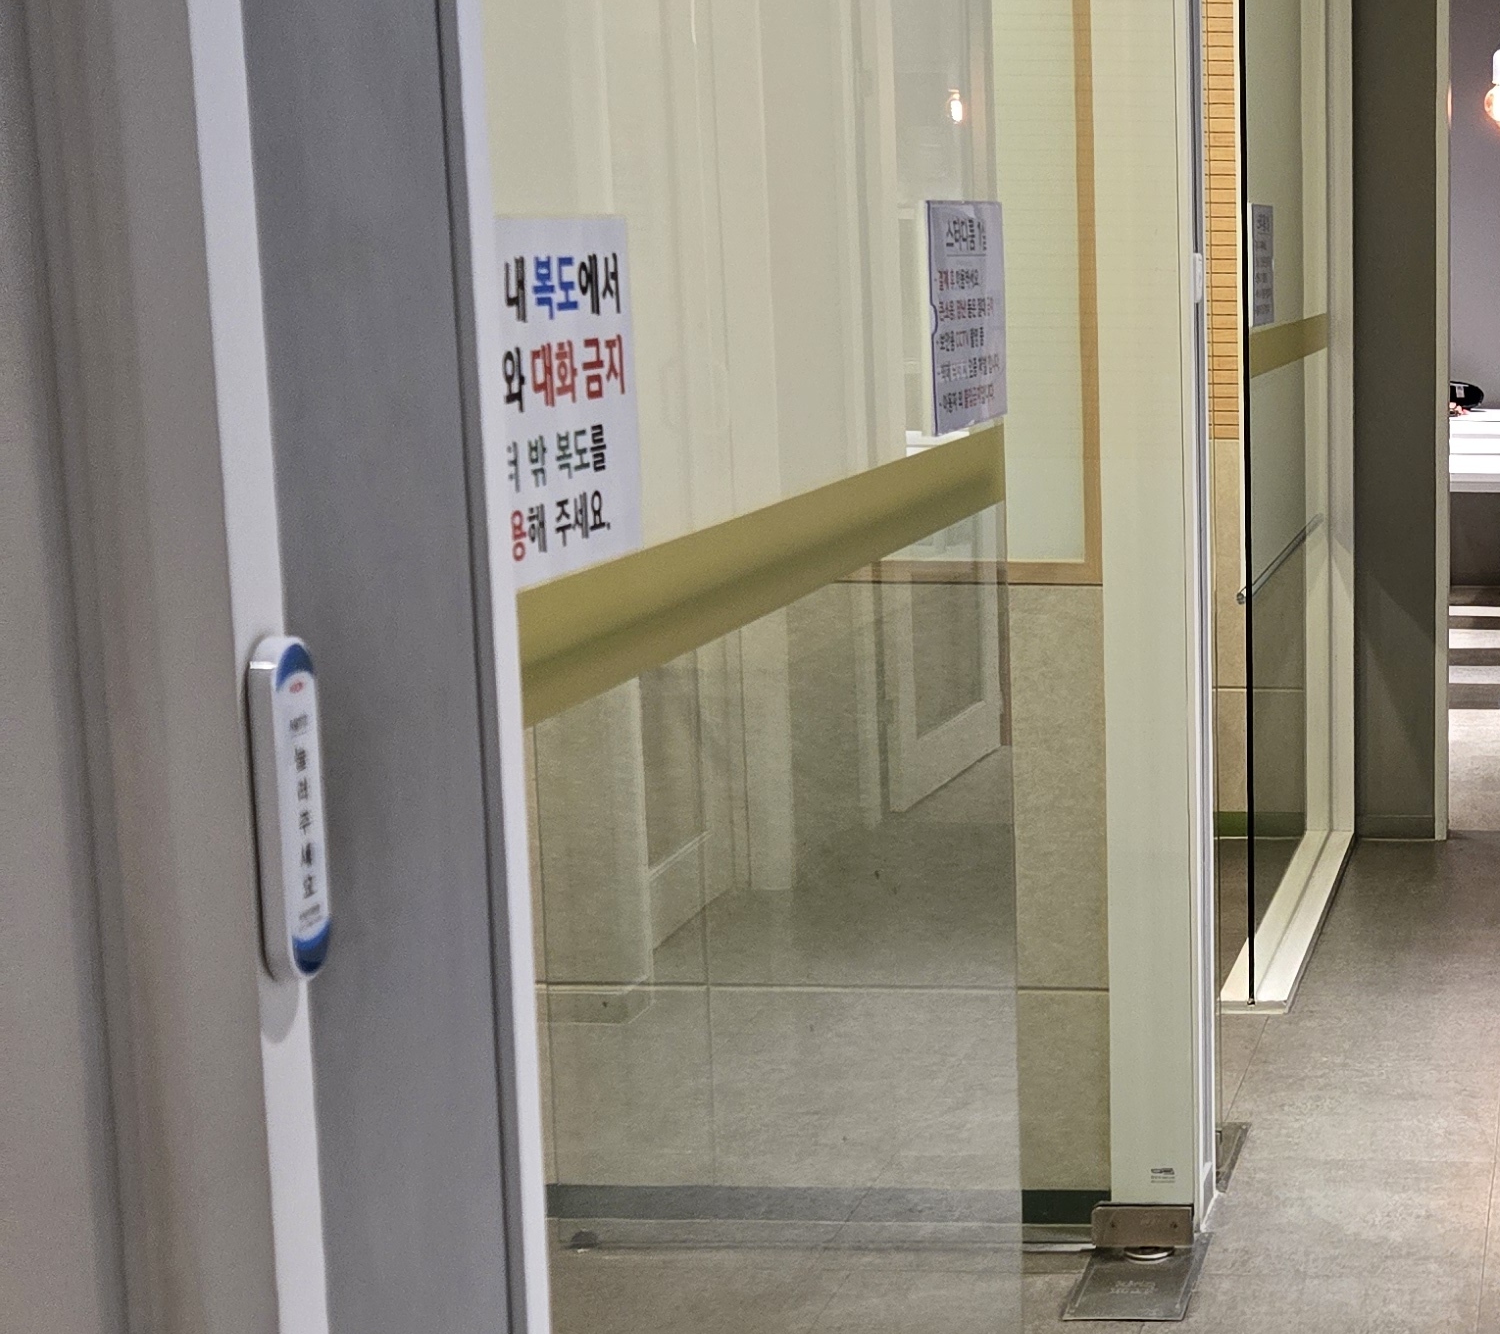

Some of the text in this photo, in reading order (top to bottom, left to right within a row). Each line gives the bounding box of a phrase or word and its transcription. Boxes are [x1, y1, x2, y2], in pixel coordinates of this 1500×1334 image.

[945, 216, 975, 251] 스터디룸
[503, 252, 621, 323] 내 복도에서
[530, 339, 578, 407] 대화
[582, 334, 625, 399] 금지
[527, 434, 548, 488] 밖
[555, 423, 607, 480] 복도를
[555, 490, 611, 547] 주세요.
